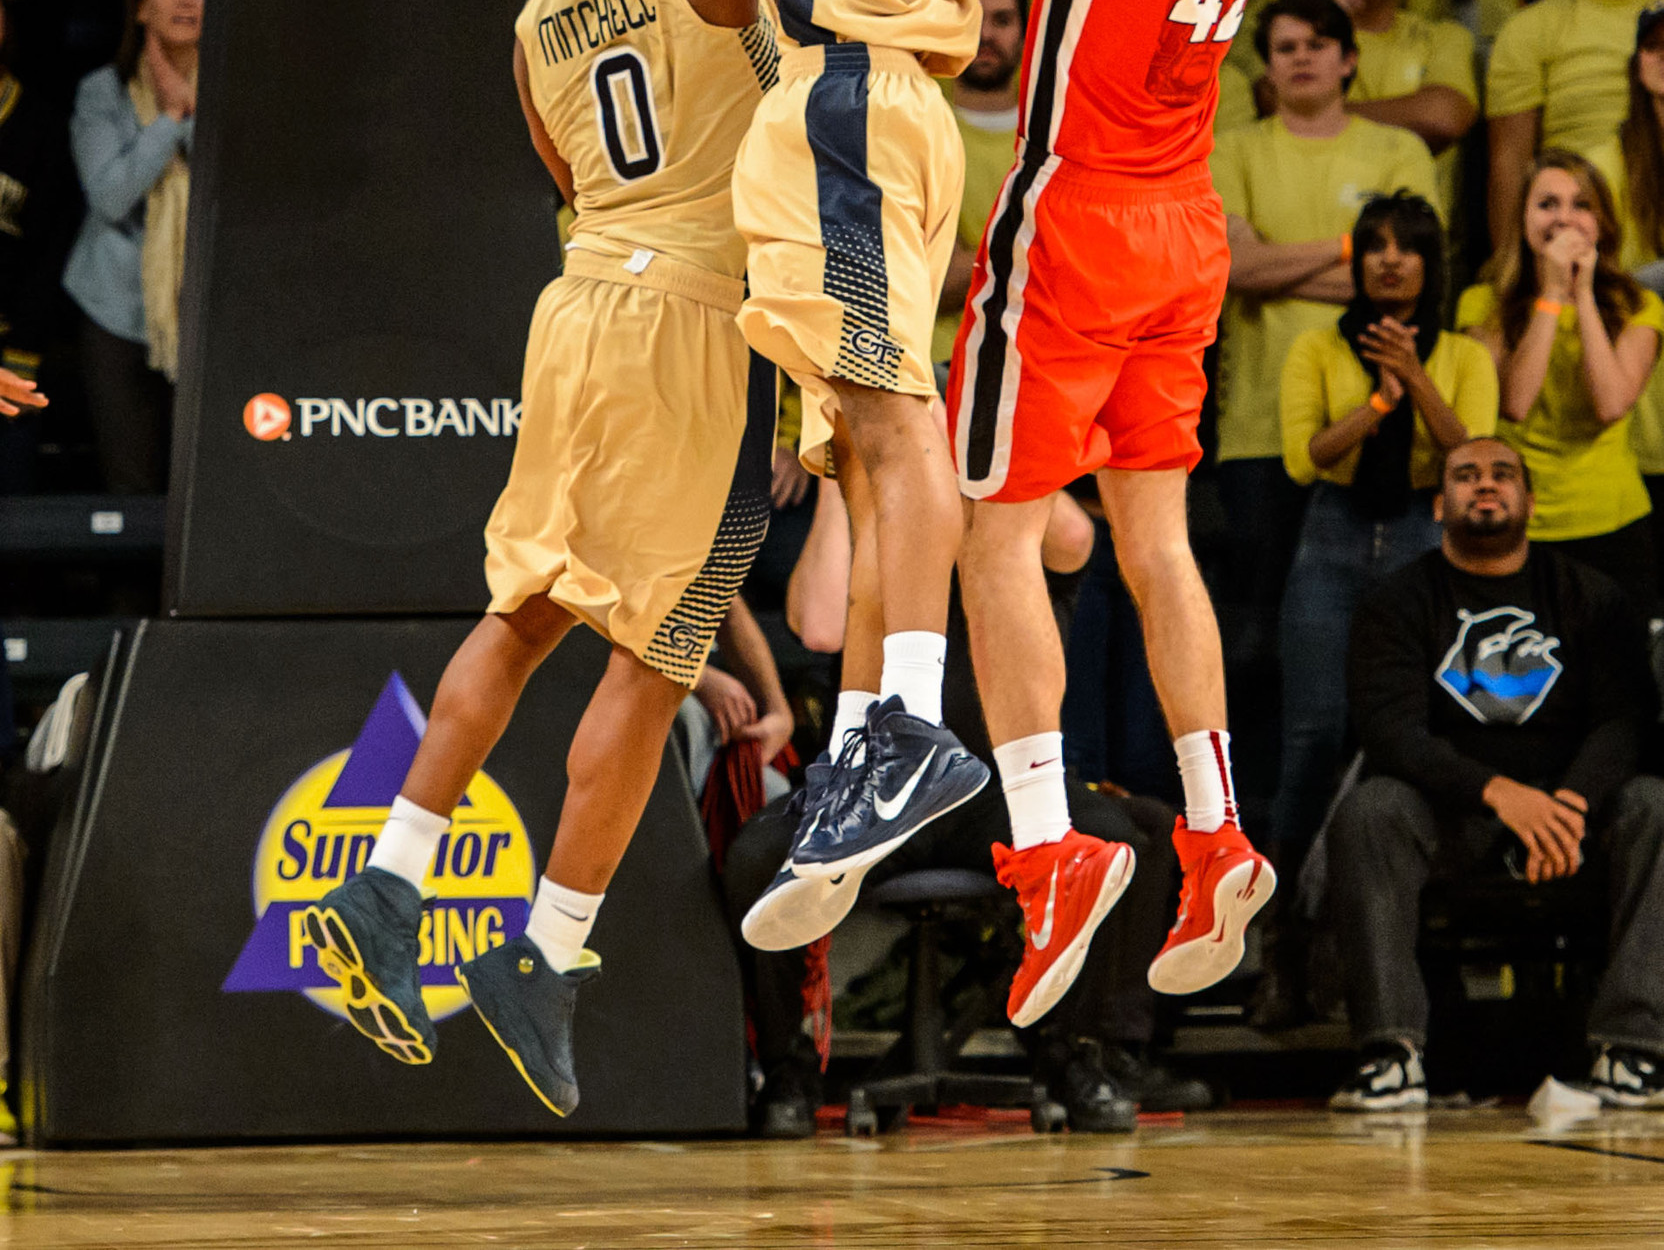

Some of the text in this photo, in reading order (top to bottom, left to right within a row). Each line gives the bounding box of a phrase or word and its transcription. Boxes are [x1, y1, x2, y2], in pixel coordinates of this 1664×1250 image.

[589, 45, 667, 186] 0
[277, 818, 512, 881] Supior
[288, 905, 506, 969] PBING
